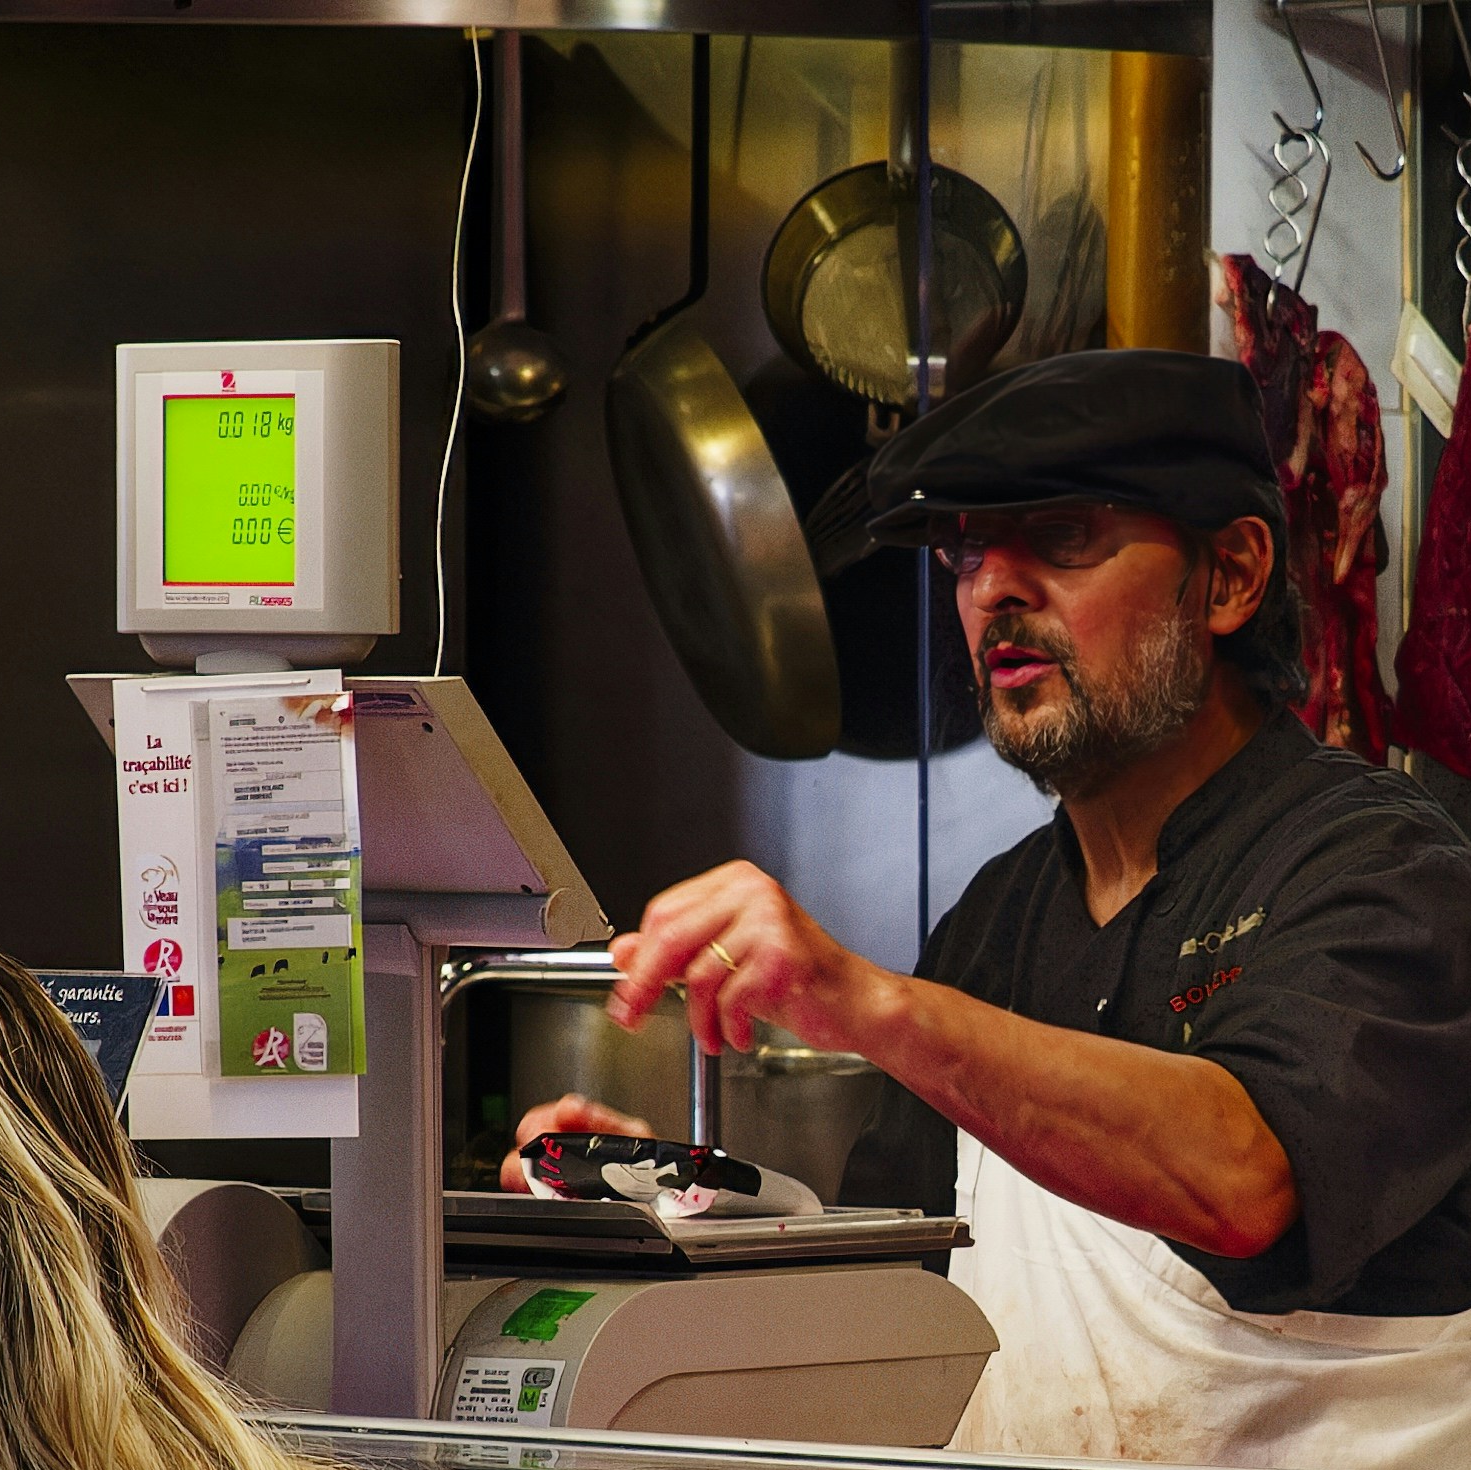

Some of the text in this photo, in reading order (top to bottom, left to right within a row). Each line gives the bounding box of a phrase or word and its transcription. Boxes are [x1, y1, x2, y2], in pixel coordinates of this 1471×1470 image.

[146, 735, 163, 750] La
[123, 755, 192, 775] traçabilité
[128, 780, 159, 795] c'est
[163, 779, 180, 793] ici
[155, 891, 179, 902] Veau
[56, 983, 124, 1006] garantie
